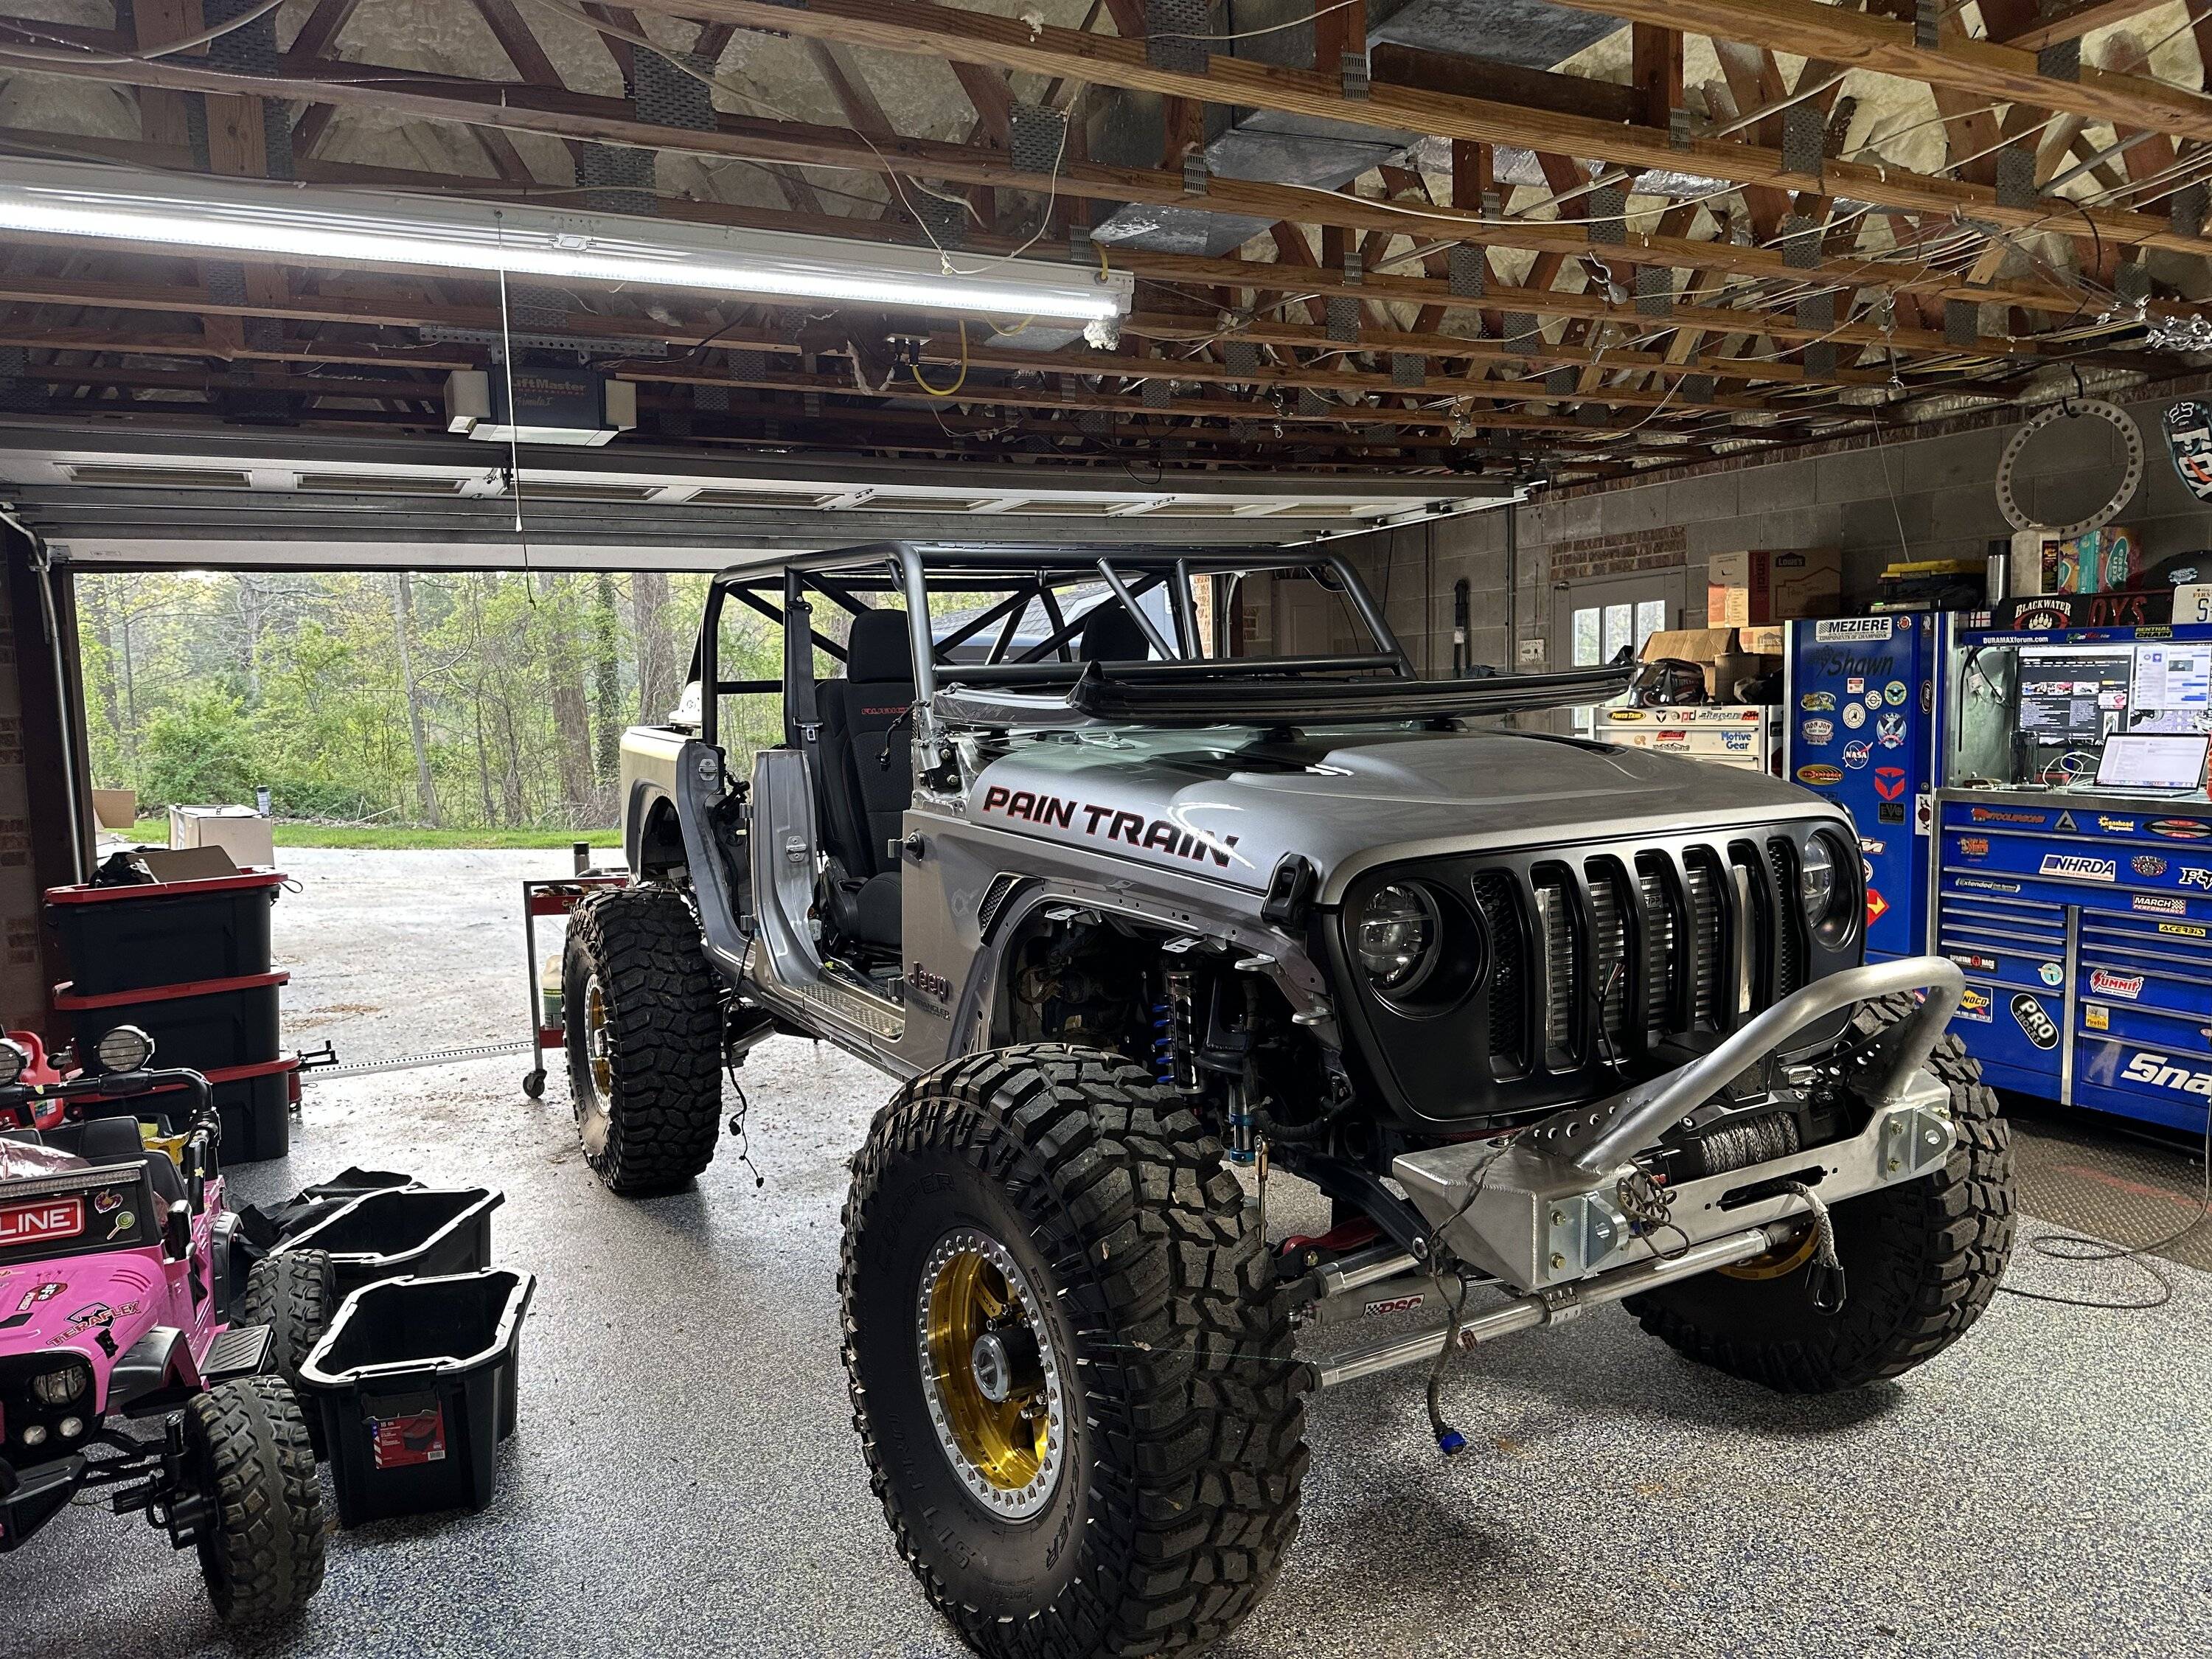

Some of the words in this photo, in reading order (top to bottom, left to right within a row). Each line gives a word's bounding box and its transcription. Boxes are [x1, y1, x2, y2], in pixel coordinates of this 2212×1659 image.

[512, 378, 586, 391] LiftMaster
[2014, 599, 2071, 619] BLACKWATER
[2197, 598, 2211, 622] S
[1829, 619, 1889, 633] MEZIERE
[1983, 636, 2048, 644] DURAMAXforum.com
[1828, 650, 1893, 676] Shawn
[1721, 731, 1751, 741] Motive
[1726, 741, 1749, 749] Gear
[982, 785, 1078, 830] PAIN
[1083, 803, 1240, 869] TRAIN
[2054, 857, 2115, 876] NHRDA
[2133, 905, 2185, 914] PERFORMANCE
[2135, 897, 2171, 908] MARCH
[1981, 959, 1995, 970] RACE
[908, 961, 950, 1004] Jeep
[1963, 995, 1988, 1006] NOCO
[2015, 1010, 2042, 1043] SHOCKS
[2020, 999, 2054, 1039] PRO
[2121, 1053, 2212, 1097] Sna
[46, 1300, 142, 1346] TERAFLEX
